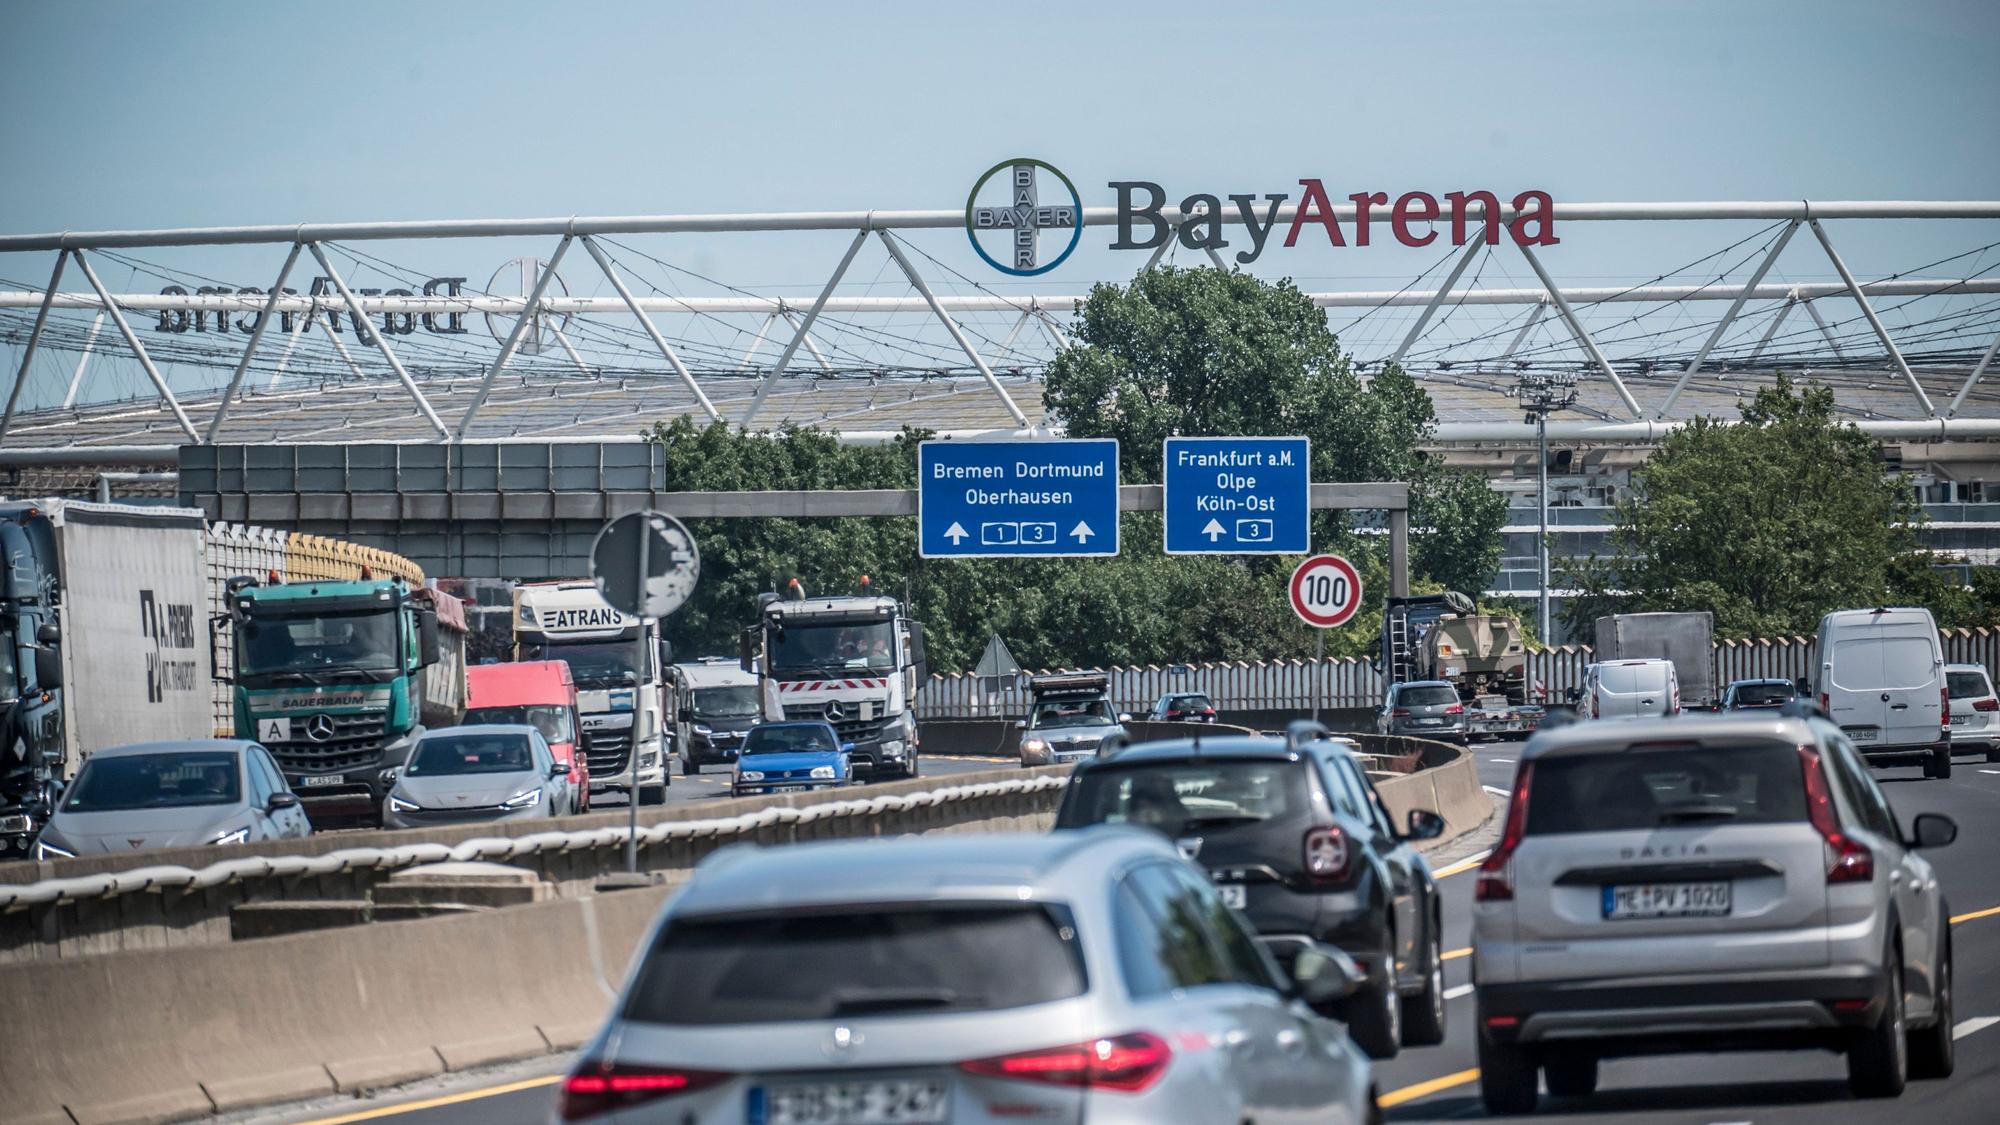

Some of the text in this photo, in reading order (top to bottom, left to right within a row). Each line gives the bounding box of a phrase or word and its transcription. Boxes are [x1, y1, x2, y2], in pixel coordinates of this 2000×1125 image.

[976, 208, 1073, 228] BAYER
[1015, 169, 1035, 268] BAYER
[1108, 178, 1560, 264] BayArena
[1178, 450, 1295, 467] Frankfurt a.M.
[934, 461, 1104, 479] Bremen Dortmund
[1217, 473, 1256, 491] Olpe
[966, 488, 1073, 505] Oberhausen
[1196, 495, 1275, 512] Köln-Ost
[996, 526, 1043, 540] 1 3
[1250, 523, 1259, 537] 3
[1306, 575, 1346, 607] 100
[282, 696, 365, 708] SAUERBAUM
[268, 721, 282, 739] A
[582, 719, 604, 727] AF
[1620, 844, 1708, 859] DACIA
[1616, 886, 1726, 911] ME PV 1020
